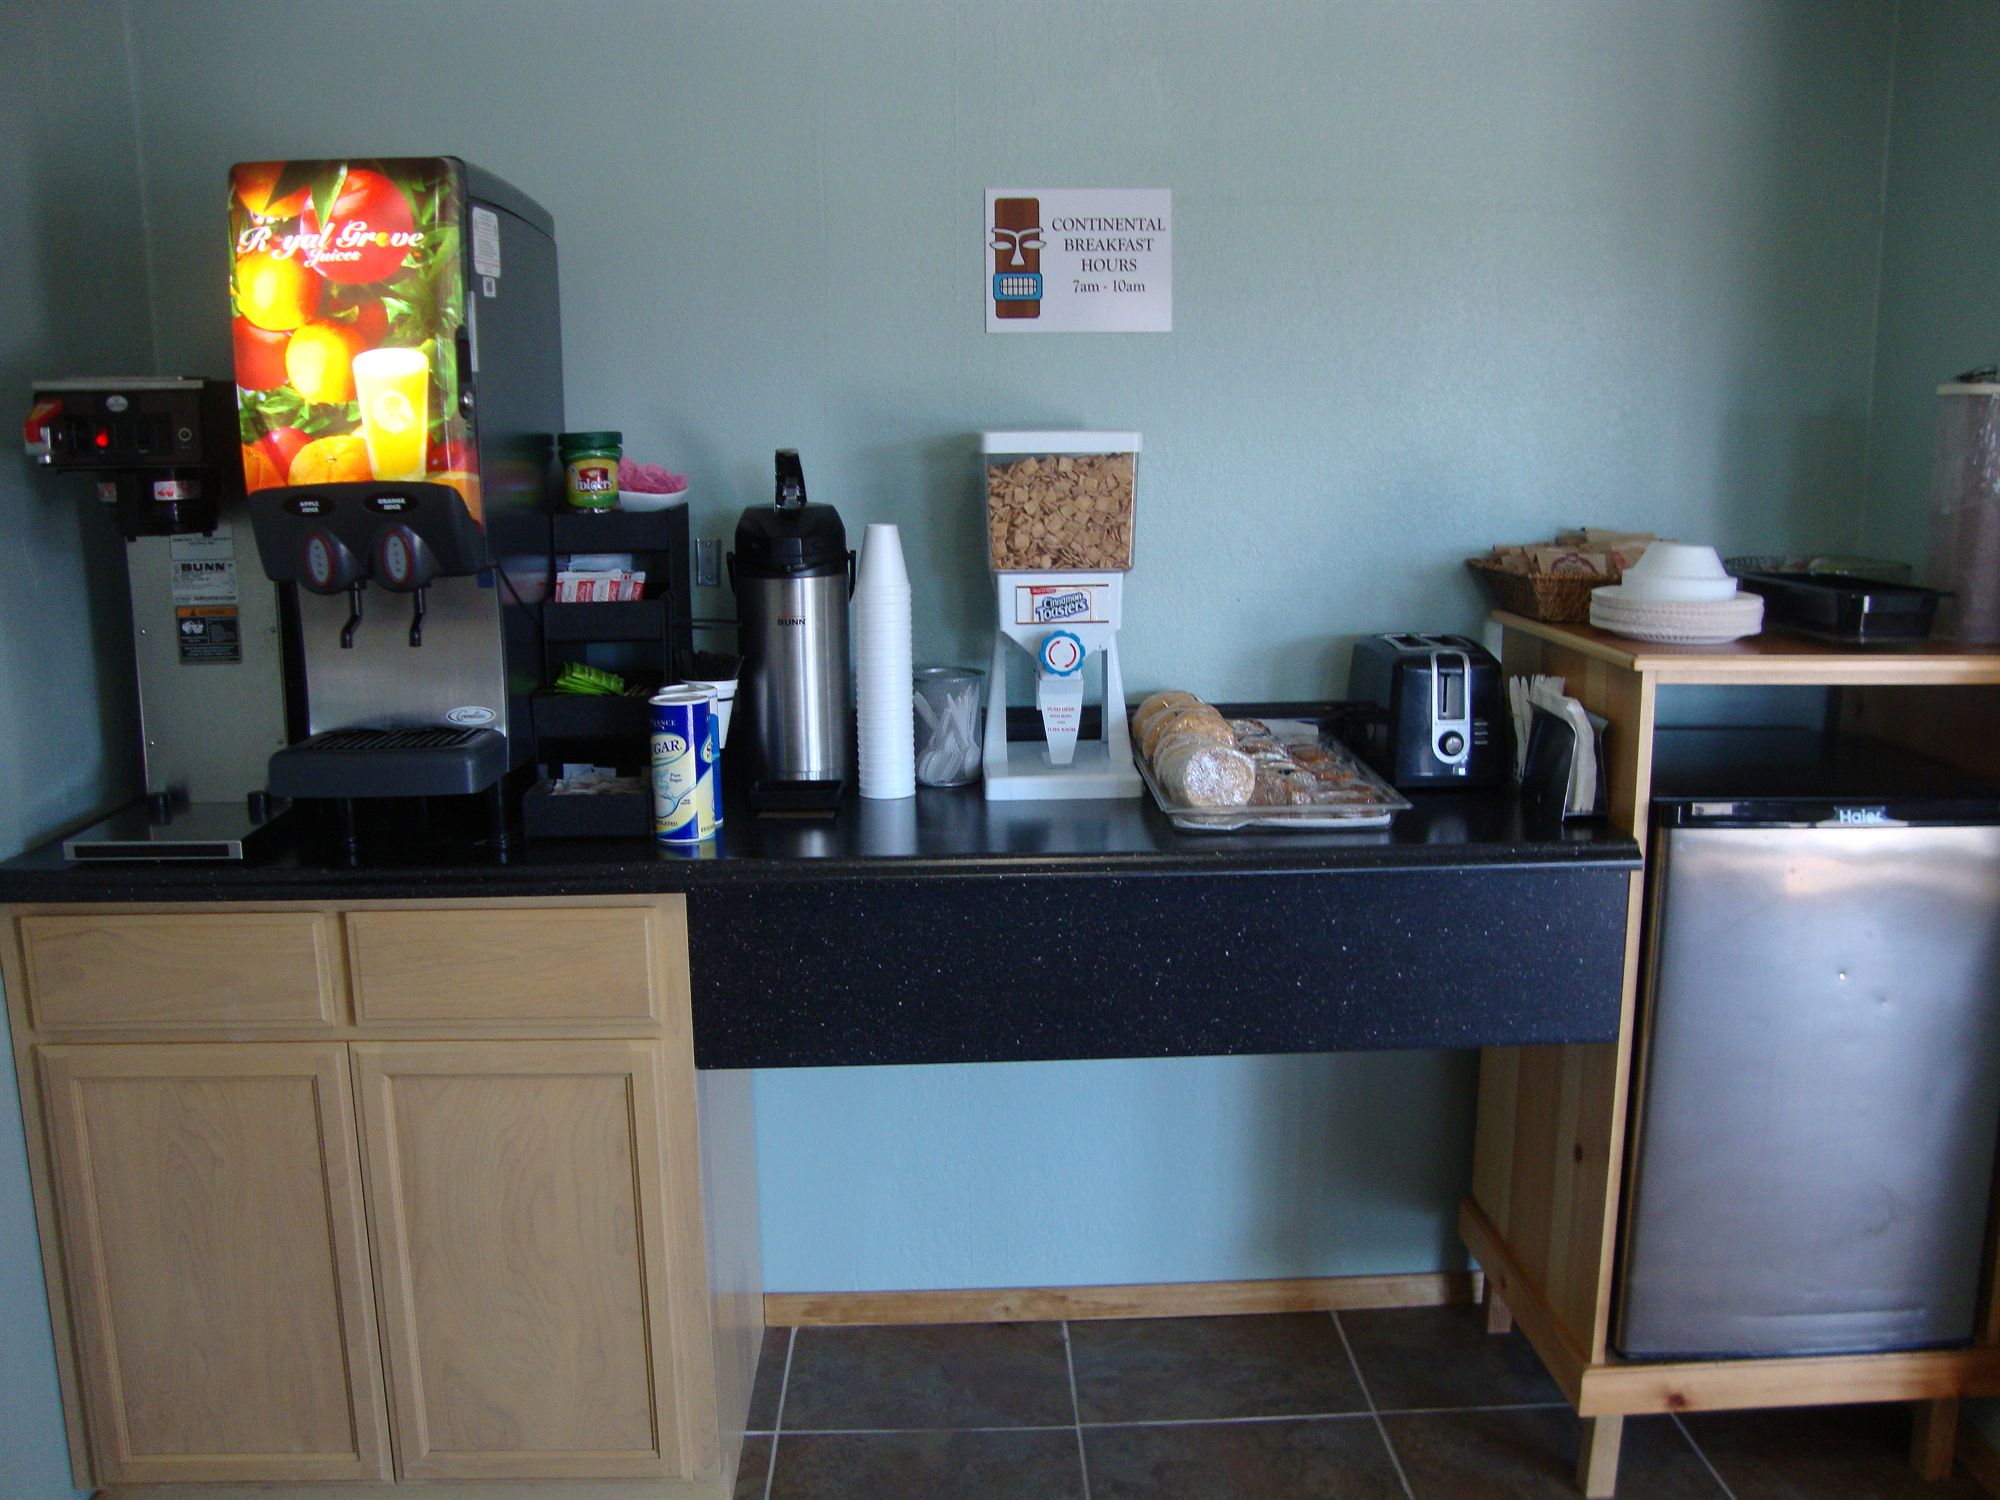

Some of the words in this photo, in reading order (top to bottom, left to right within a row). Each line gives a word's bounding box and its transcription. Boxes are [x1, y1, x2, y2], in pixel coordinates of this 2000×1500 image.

[1051, 217, 1166, 232] CONTINENTAL
[336, 221, 424, 247] Grove
[1064, 238, 1155, 252] BREAKFAST
[304, 249, 362, 267] Juices
[1081, 258, 1137, 272] HOURS
[1072, 279, 1100, 293] 7am
[1112, 279, 1146, 293] 10am
[181, 563, 226, 572] BUNN
[1042, 592, 1083, 607] Cinnamon
[1036, 599, 1088, 621] Toasters
